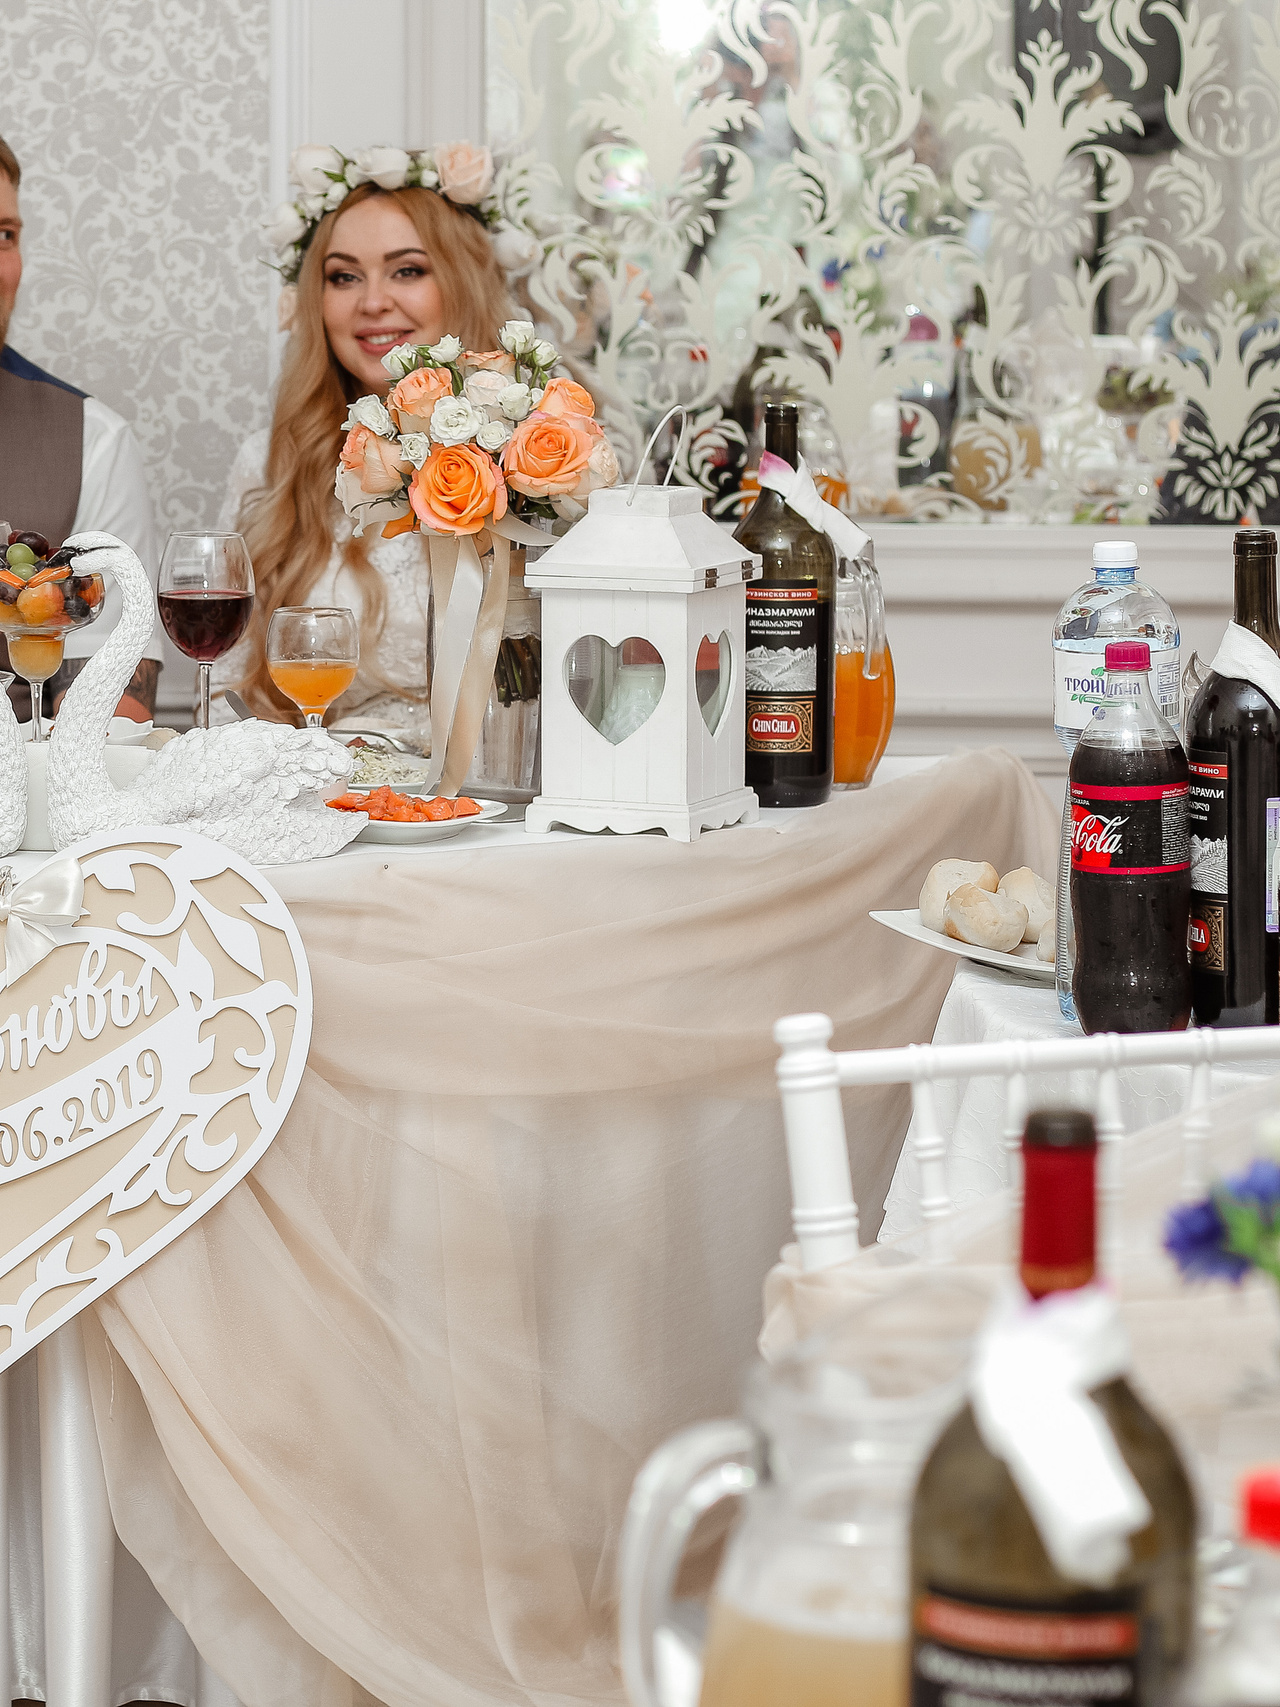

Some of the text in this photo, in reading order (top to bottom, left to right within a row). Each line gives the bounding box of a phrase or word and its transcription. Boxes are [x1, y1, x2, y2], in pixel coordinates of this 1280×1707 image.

[745, 607, 815, 617] ИНДЗМАРАУЛИ
[1198, 766, 1220, 775] ВИНО
[1190, 785, 1225, 799] АРАУЛИ
